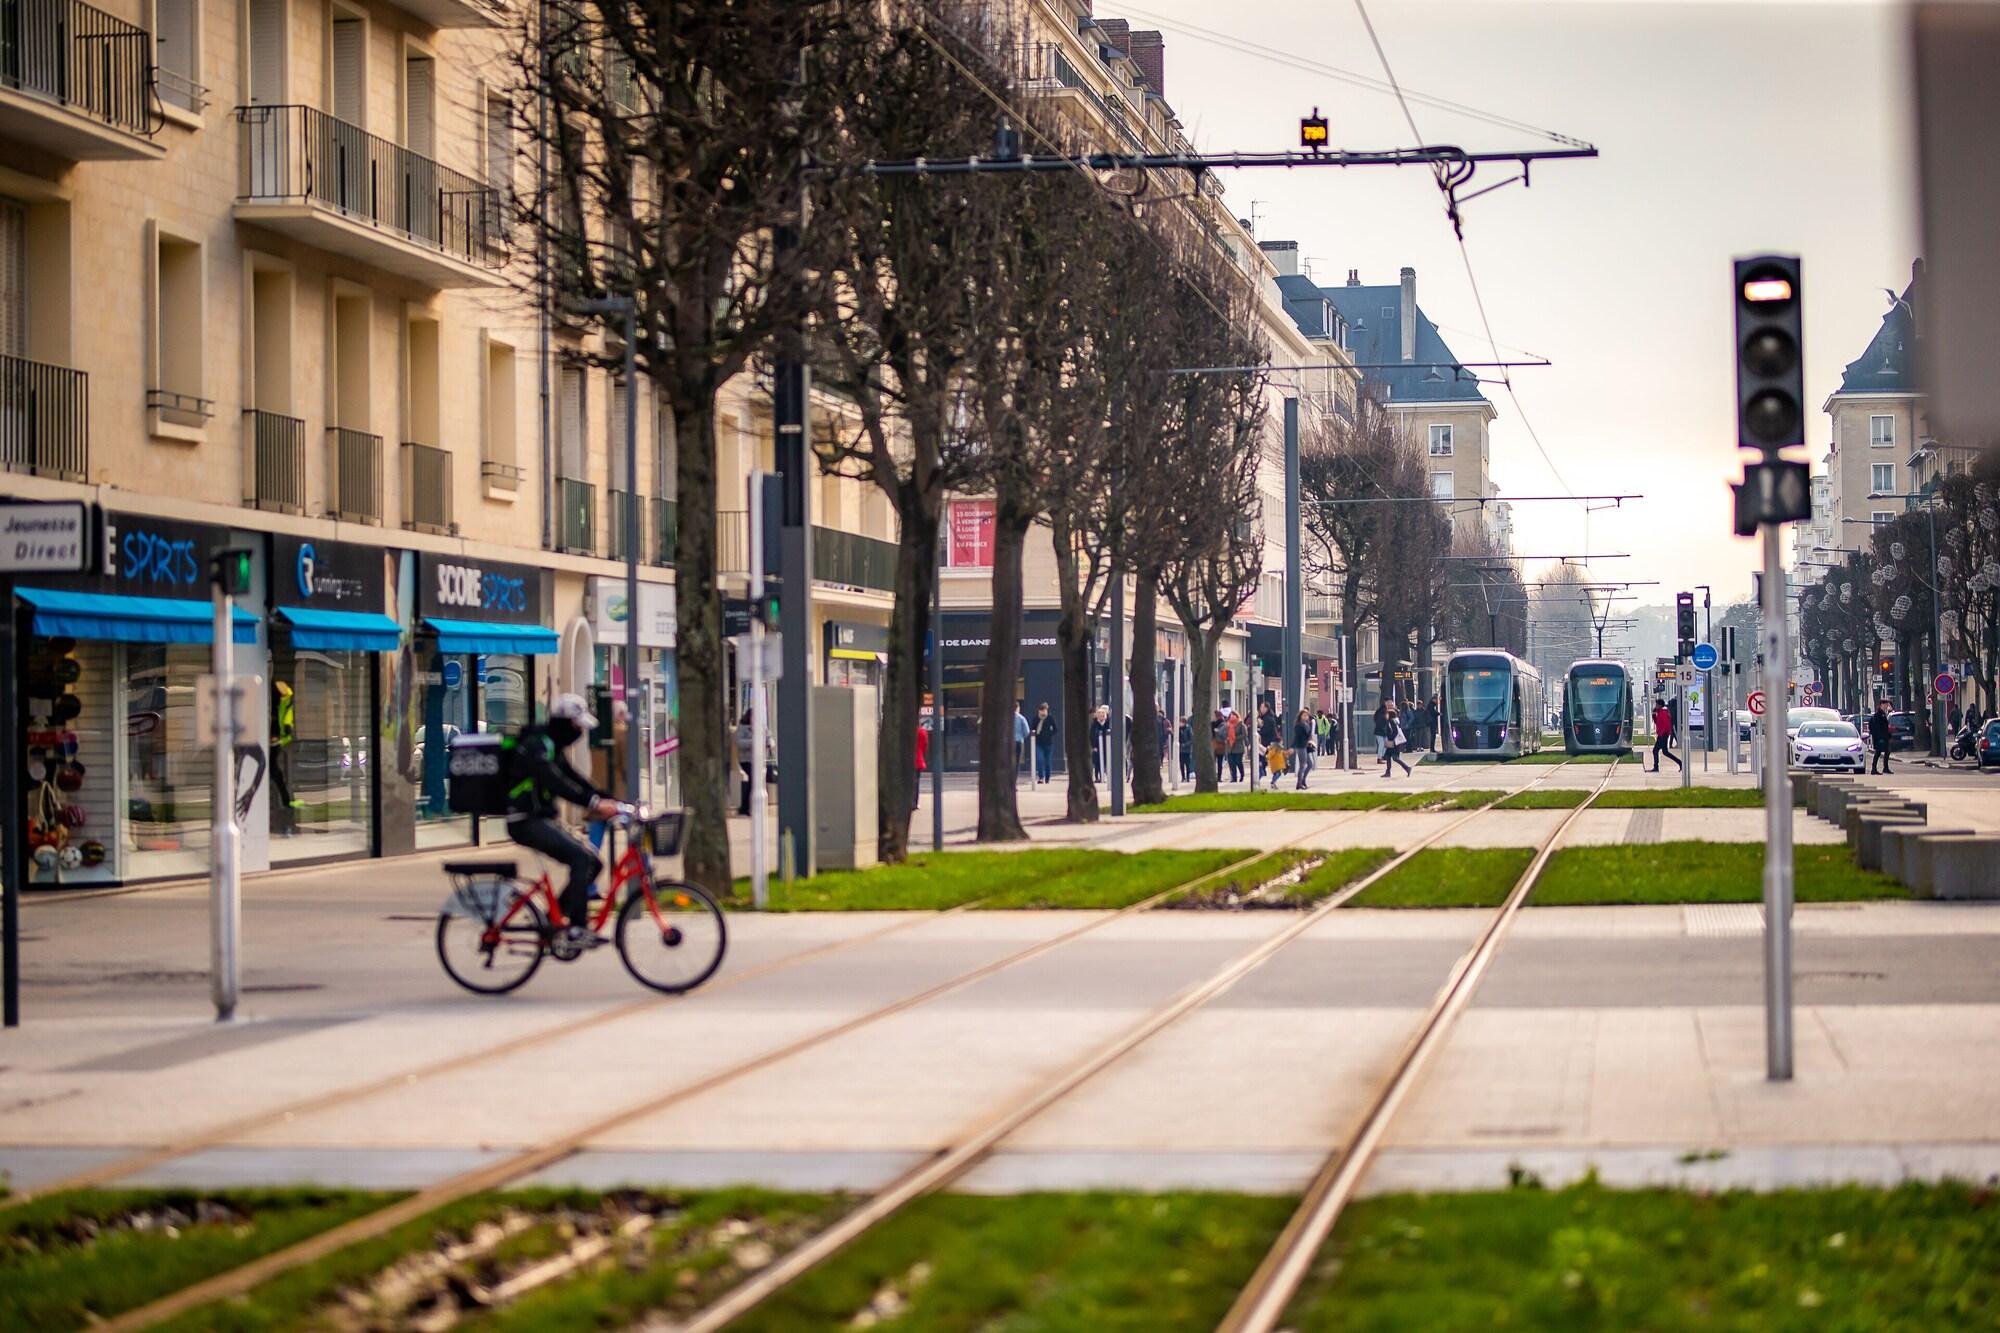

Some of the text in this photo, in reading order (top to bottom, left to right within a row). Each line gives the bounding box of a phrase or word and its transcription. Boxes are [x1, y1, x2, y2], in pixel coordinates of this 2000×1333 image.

[15, 541, 77, 560] Direct
[123, 530, 198, 585] SPORTS
[437, 563, 482, 607] SCORE
[961, 639, 991, 647] BAINS
[1680, 671, 1692, 681] 15
